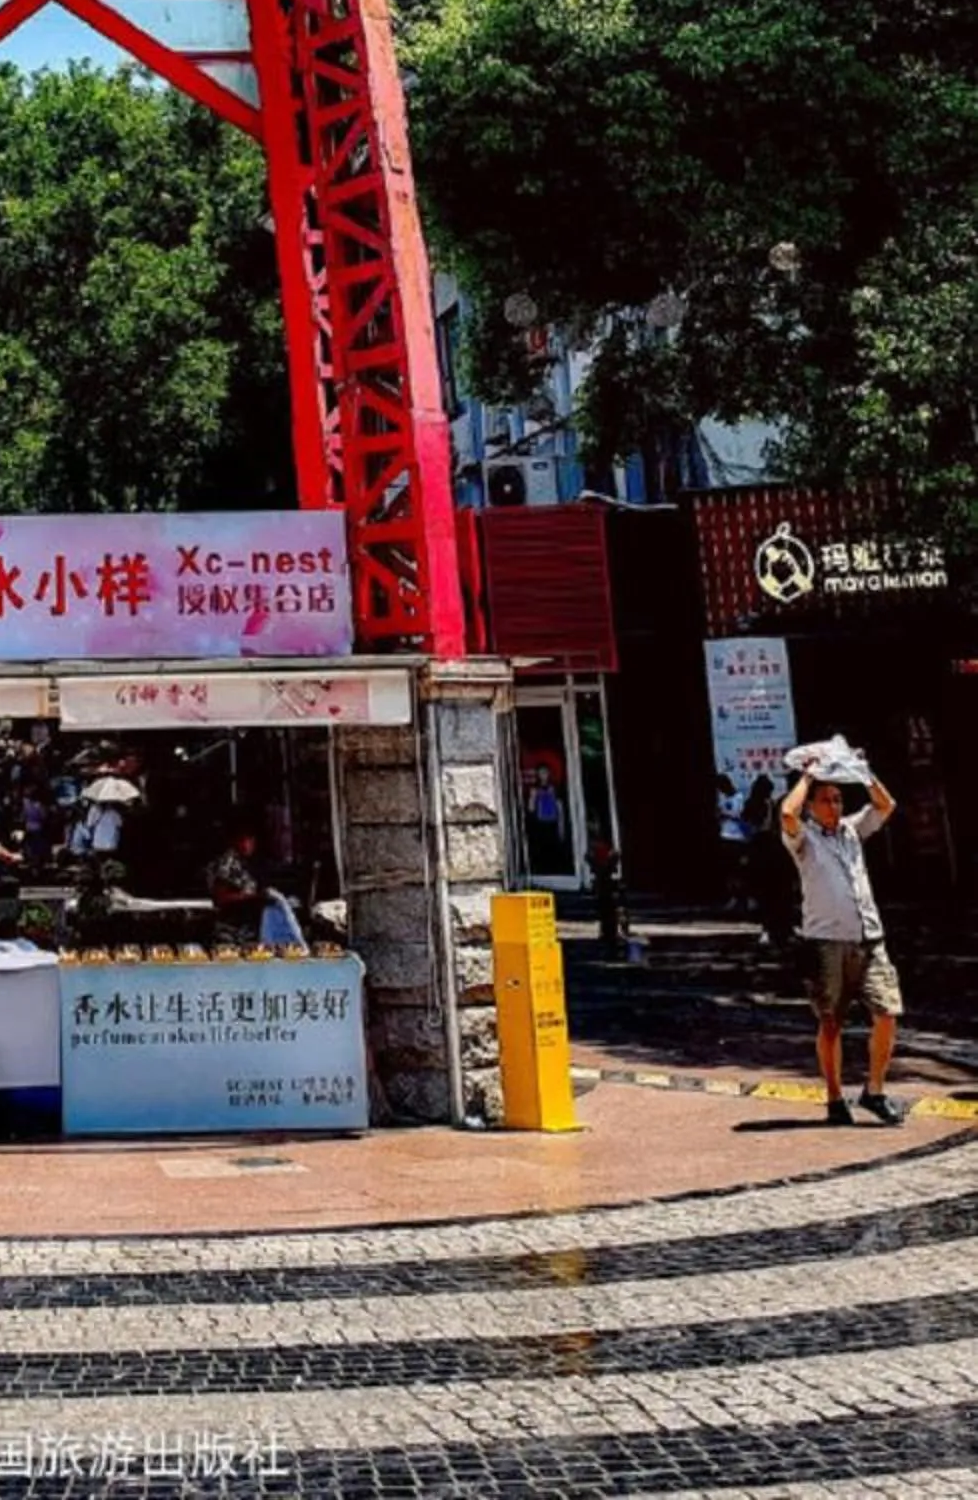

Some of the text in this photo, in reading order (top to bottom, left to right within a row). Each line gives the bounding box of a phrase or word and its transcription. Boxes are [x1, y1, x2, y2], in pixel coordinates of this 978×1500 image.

[177, 545, 333, 576] Xc-nest
[177, 583, 335, 616] 授权集合店
[73, 988, 350, 1026] 香水让生活更加美好
[70, 1028, 147, 1049] perfume
